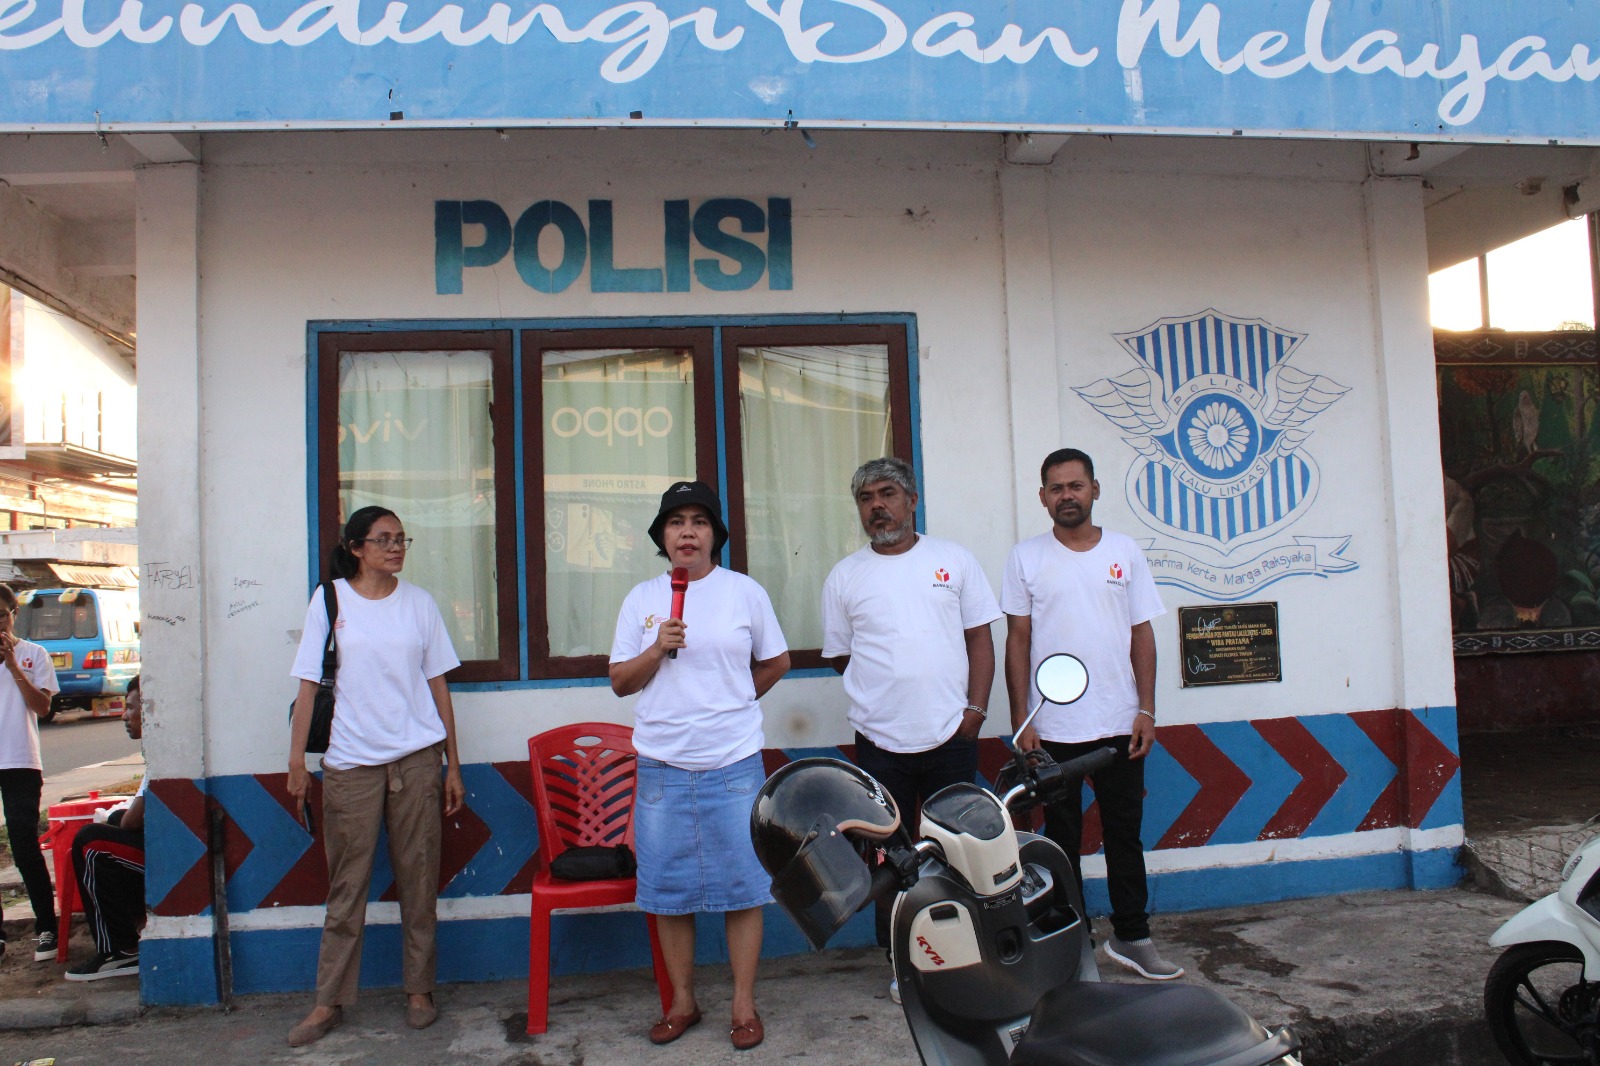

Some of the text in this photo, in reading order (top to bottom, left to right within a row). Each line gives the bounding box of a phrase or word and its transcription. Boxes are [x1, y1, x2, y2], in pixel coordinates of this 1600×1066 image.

[435, 196, 793, 294] POLISI
[1174, 378, 1255, 405] POLISI
[1179, 464, 1265, 497] LALU LINTAS
[1146, 551, 1312, 585] harma Kerta Marga Raksyaka
